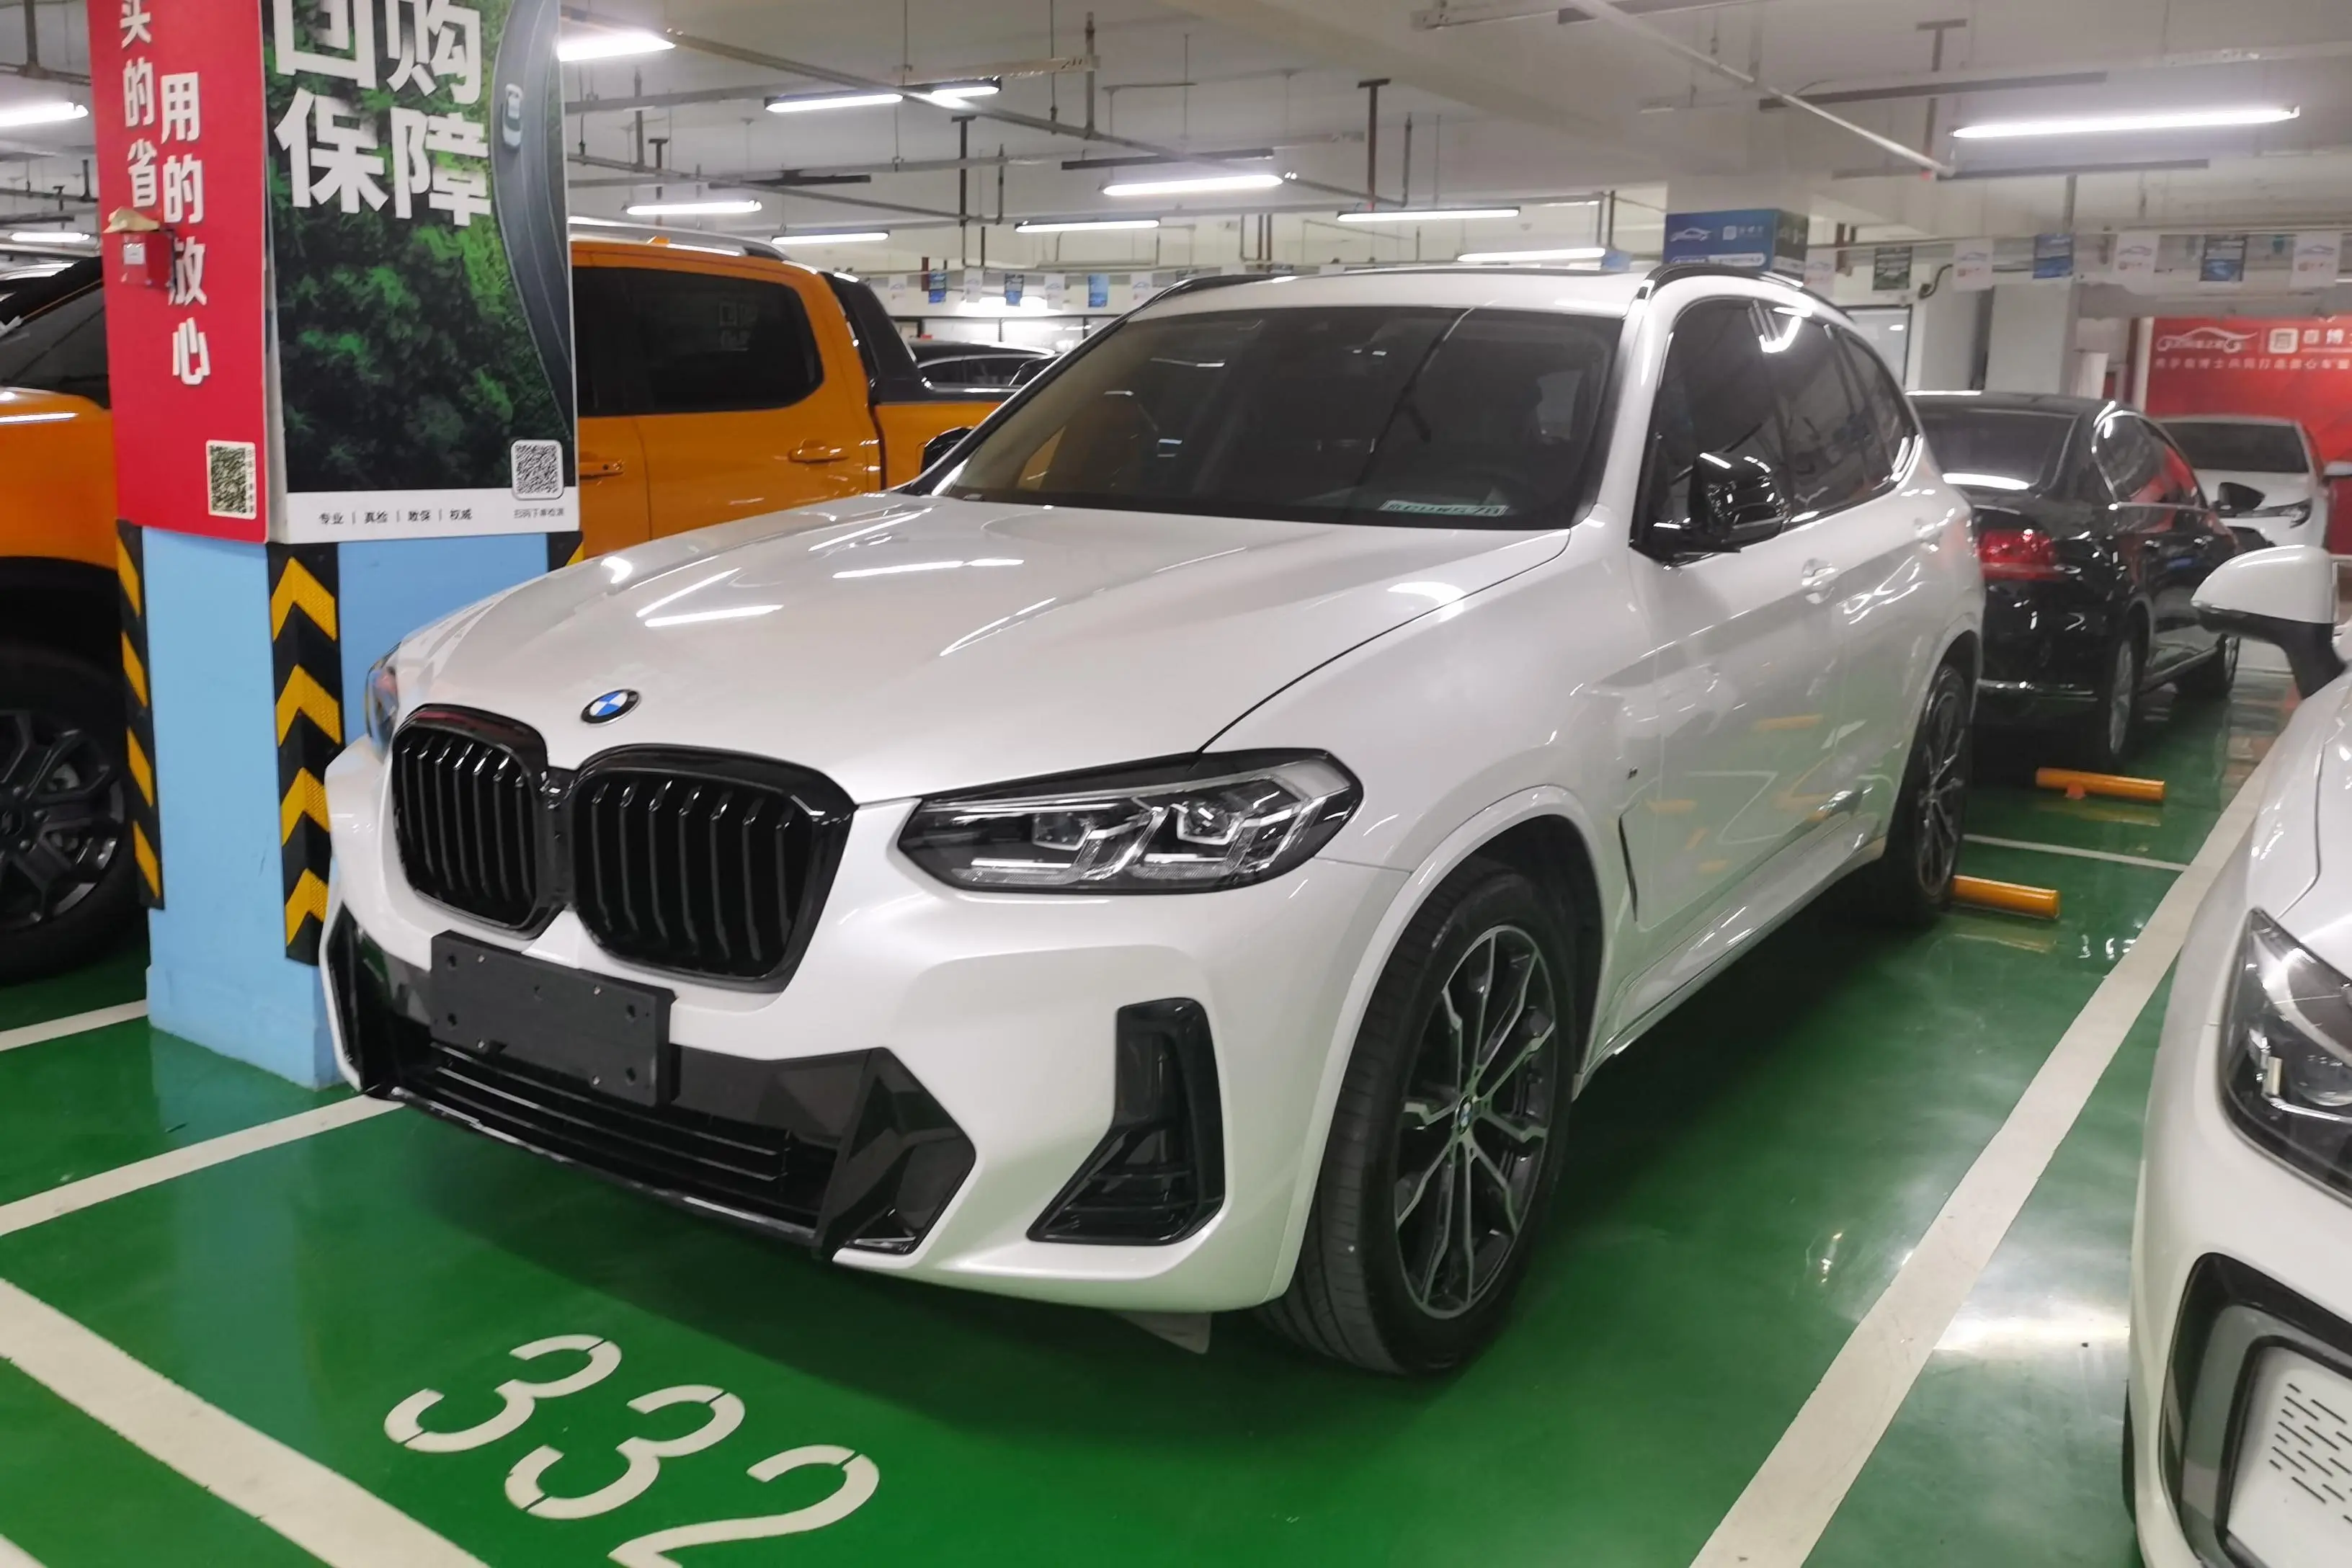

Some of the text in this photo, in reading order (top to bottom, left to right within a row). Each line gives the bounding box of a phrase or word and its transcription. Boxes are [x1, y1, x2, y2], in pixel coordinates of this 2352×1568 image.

[120, 0, 158, 208] 买的省
[273, 0, 481, 104] 回购
[274, 86, 491, 226] 保障
[160, 72, 210, 386] 用的放心
[384, 1333, 881, 1568] 332
